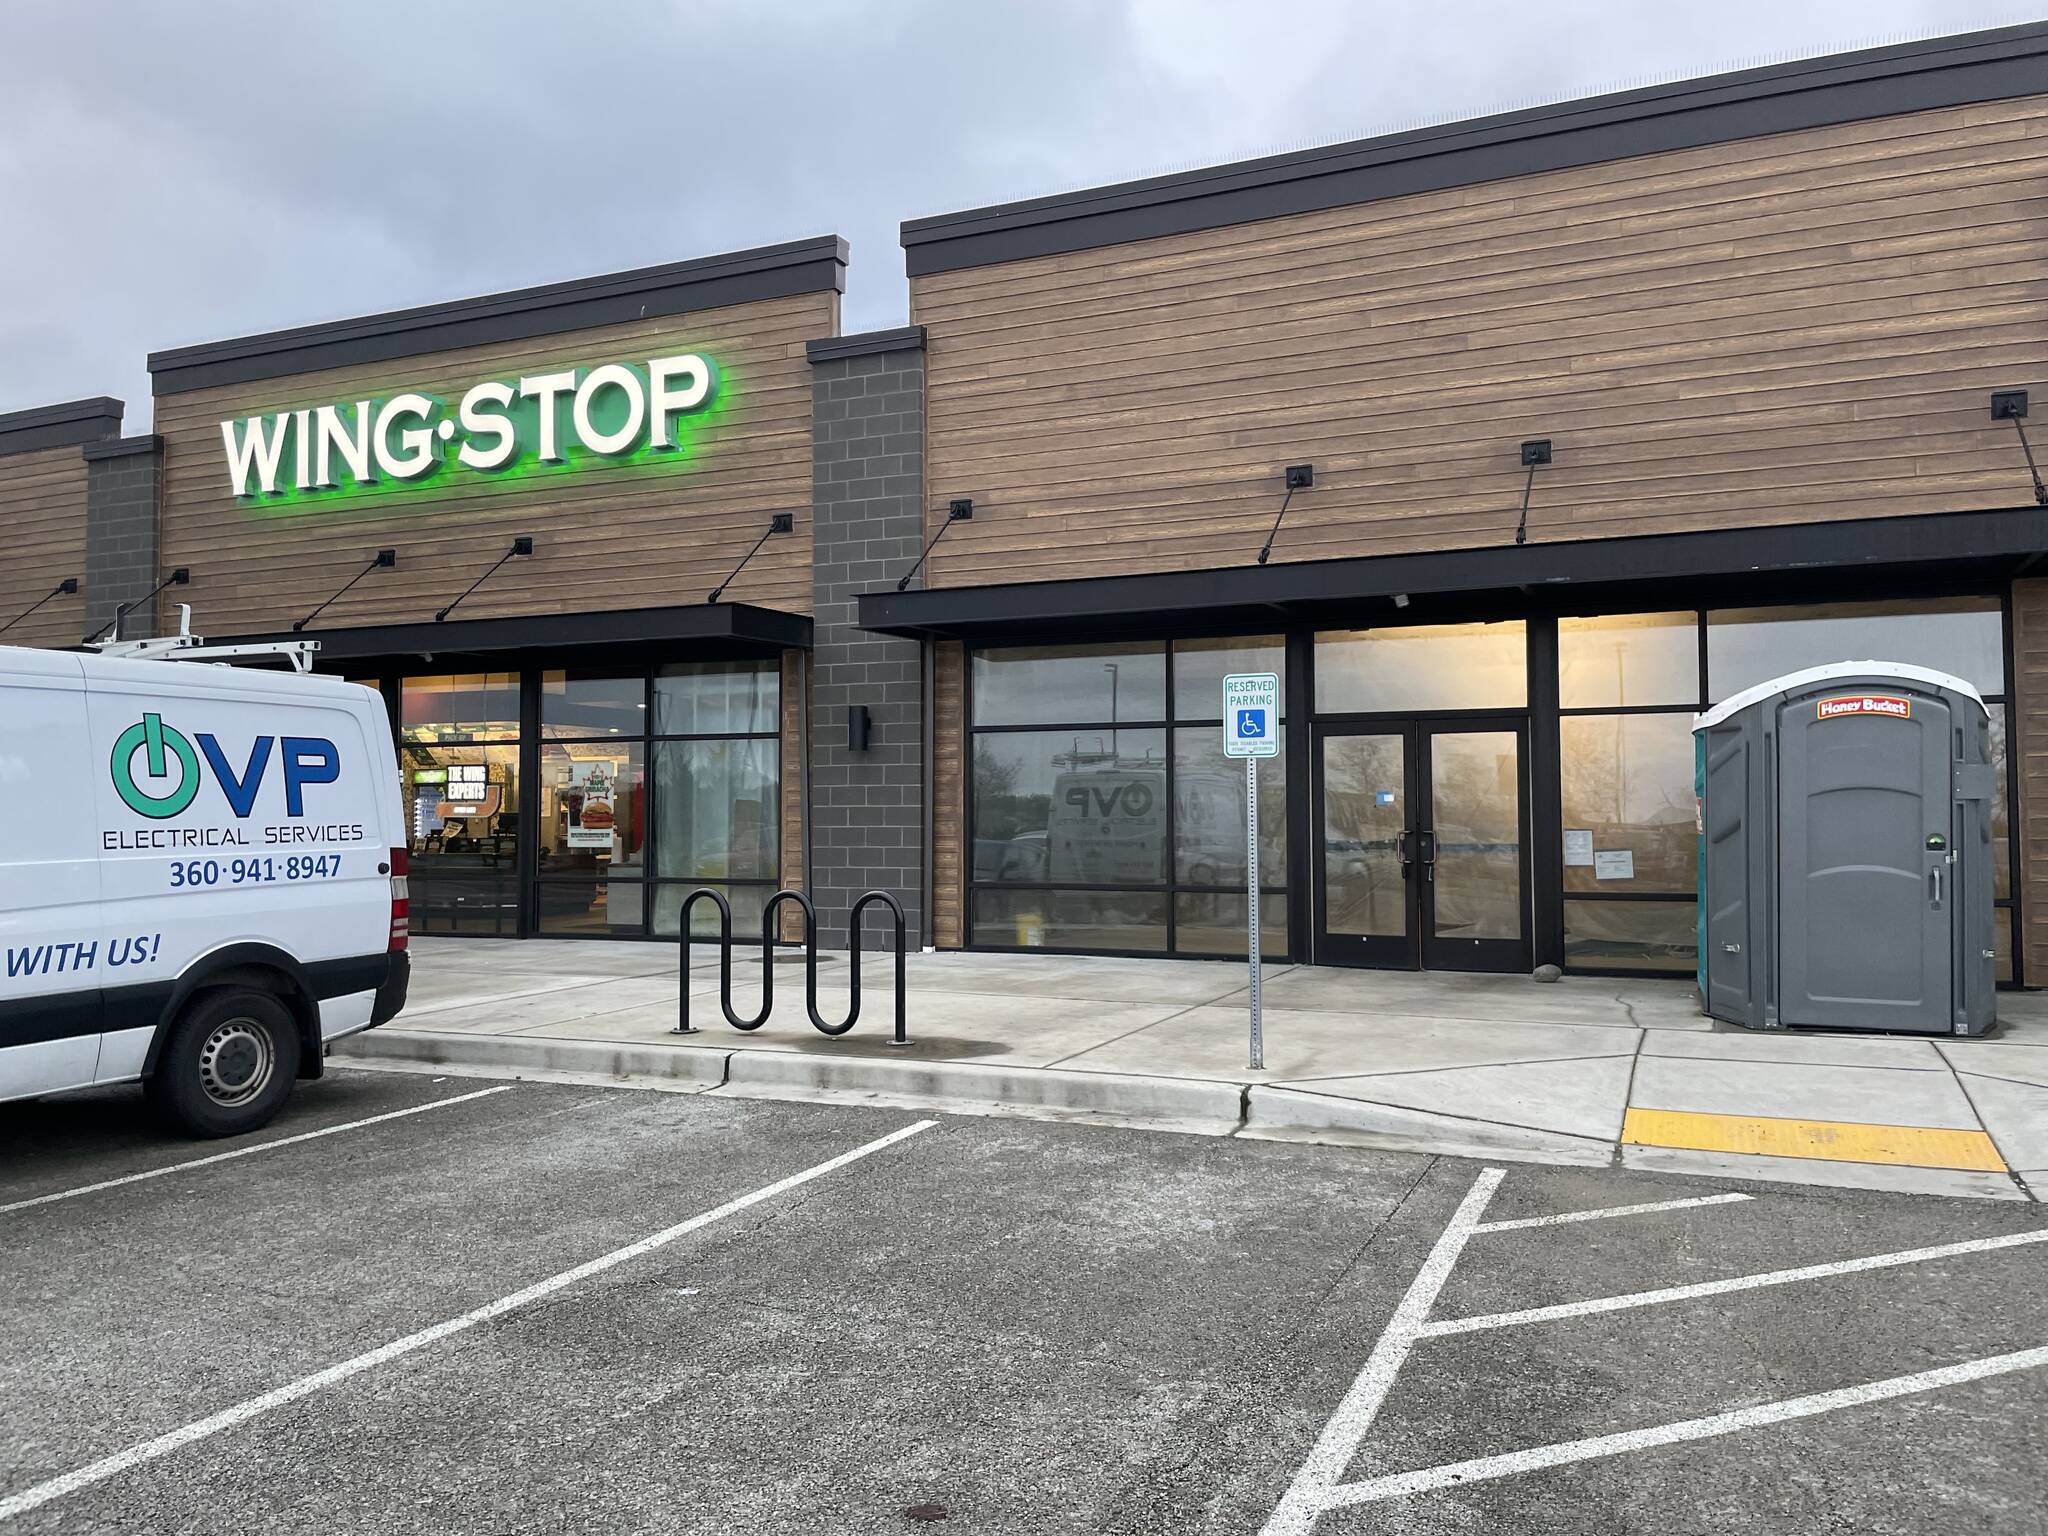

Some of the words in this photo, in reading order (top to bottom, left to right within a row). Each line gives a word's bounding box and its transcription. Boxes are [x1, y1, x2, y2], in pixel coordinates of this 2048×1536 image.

[1228, 681, 1274, 692] RESERVED
[1230, 694, 1272, 706] PARKING
[1821, 702, 1861, 716] Honey
[1863, 699, 1906, 714] Bucket
[448, 766, 462, 781] THE
[463, 766, 486, 781] WING
[448, 782, 485, 799] EXPERTS
[103, 828, 250, 850] ELECTRICAL
[264, 824, 363, 844] SERVICES
[7, 941, 98, 977] WITH
[107, 933, 161, 967] US!
